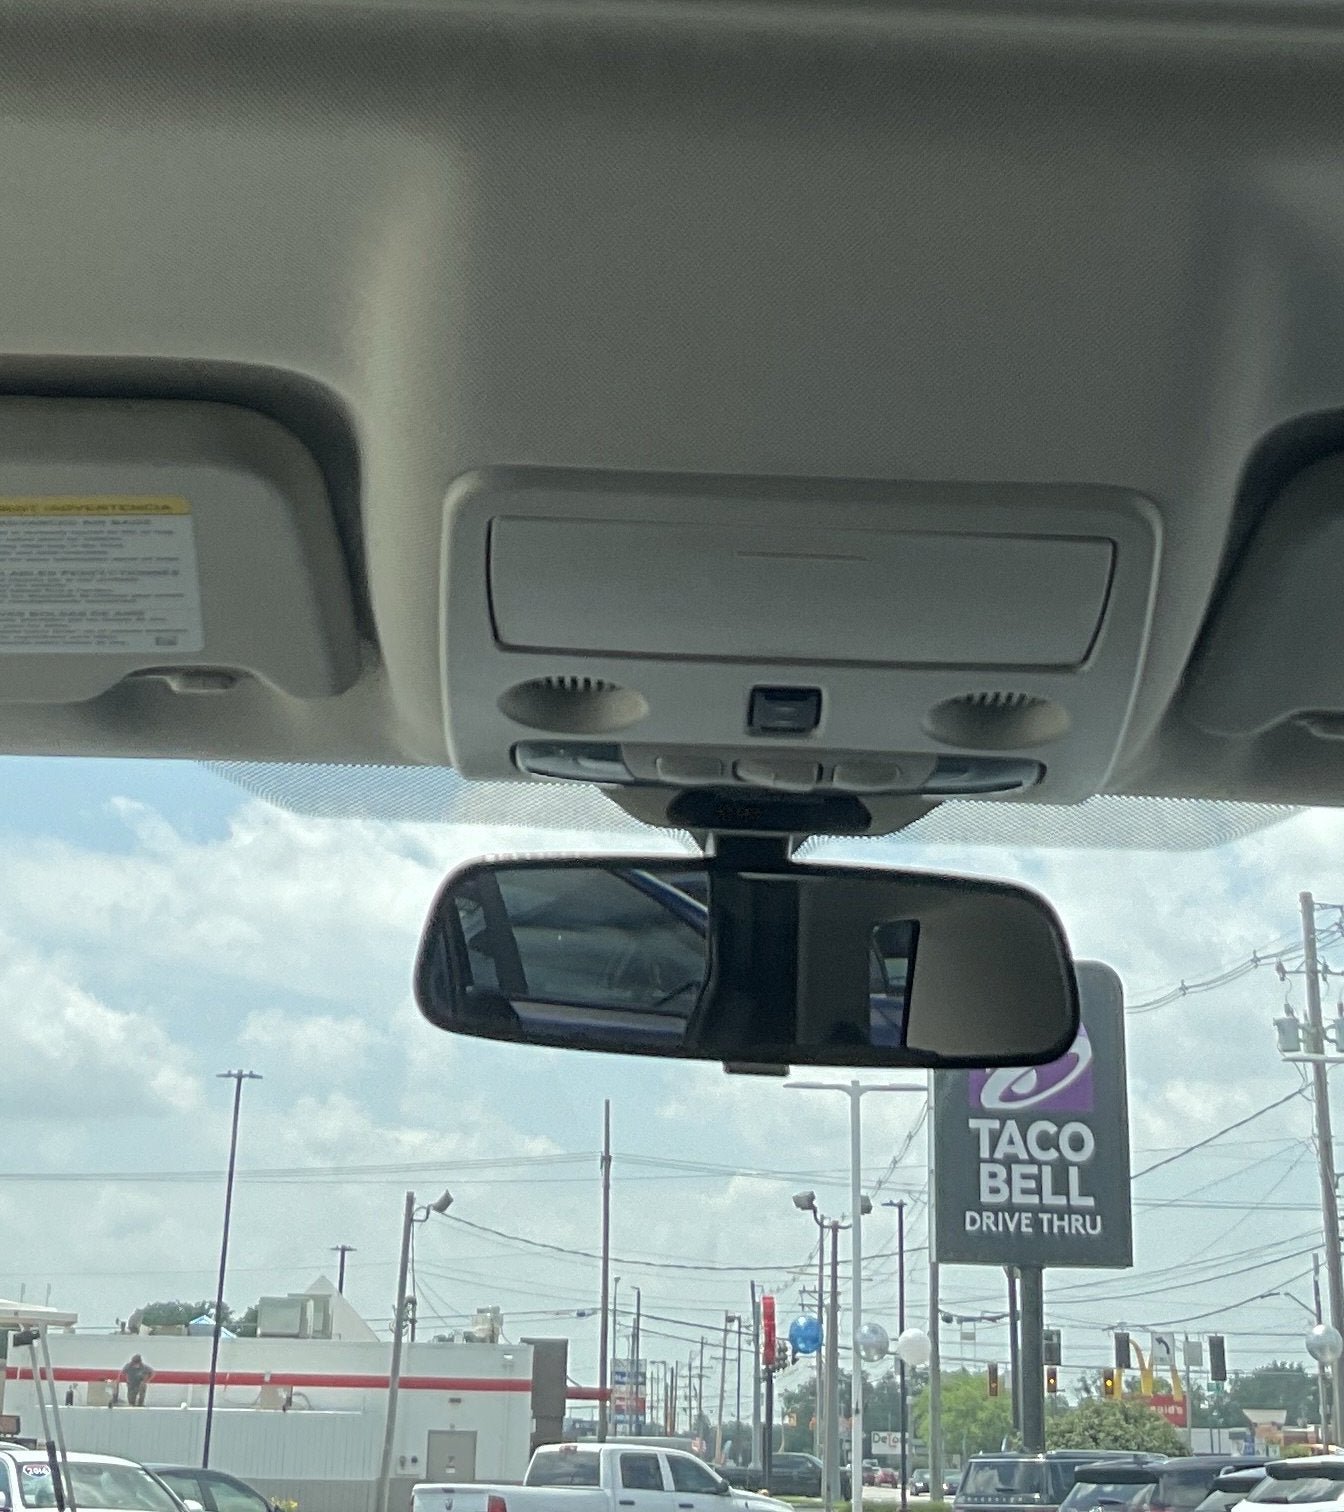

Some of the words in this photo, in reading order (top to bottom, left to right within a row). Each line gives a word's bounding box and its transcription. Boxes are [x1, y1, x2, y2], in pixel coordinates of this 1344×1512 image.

[968, 1118, 1095, 1162] TACO
[980, 1164, 1095, 1206] BELL
[964, 1210, 1033, 1234] DRIVE
[1038, 1212, 1102, 1236] THRU
